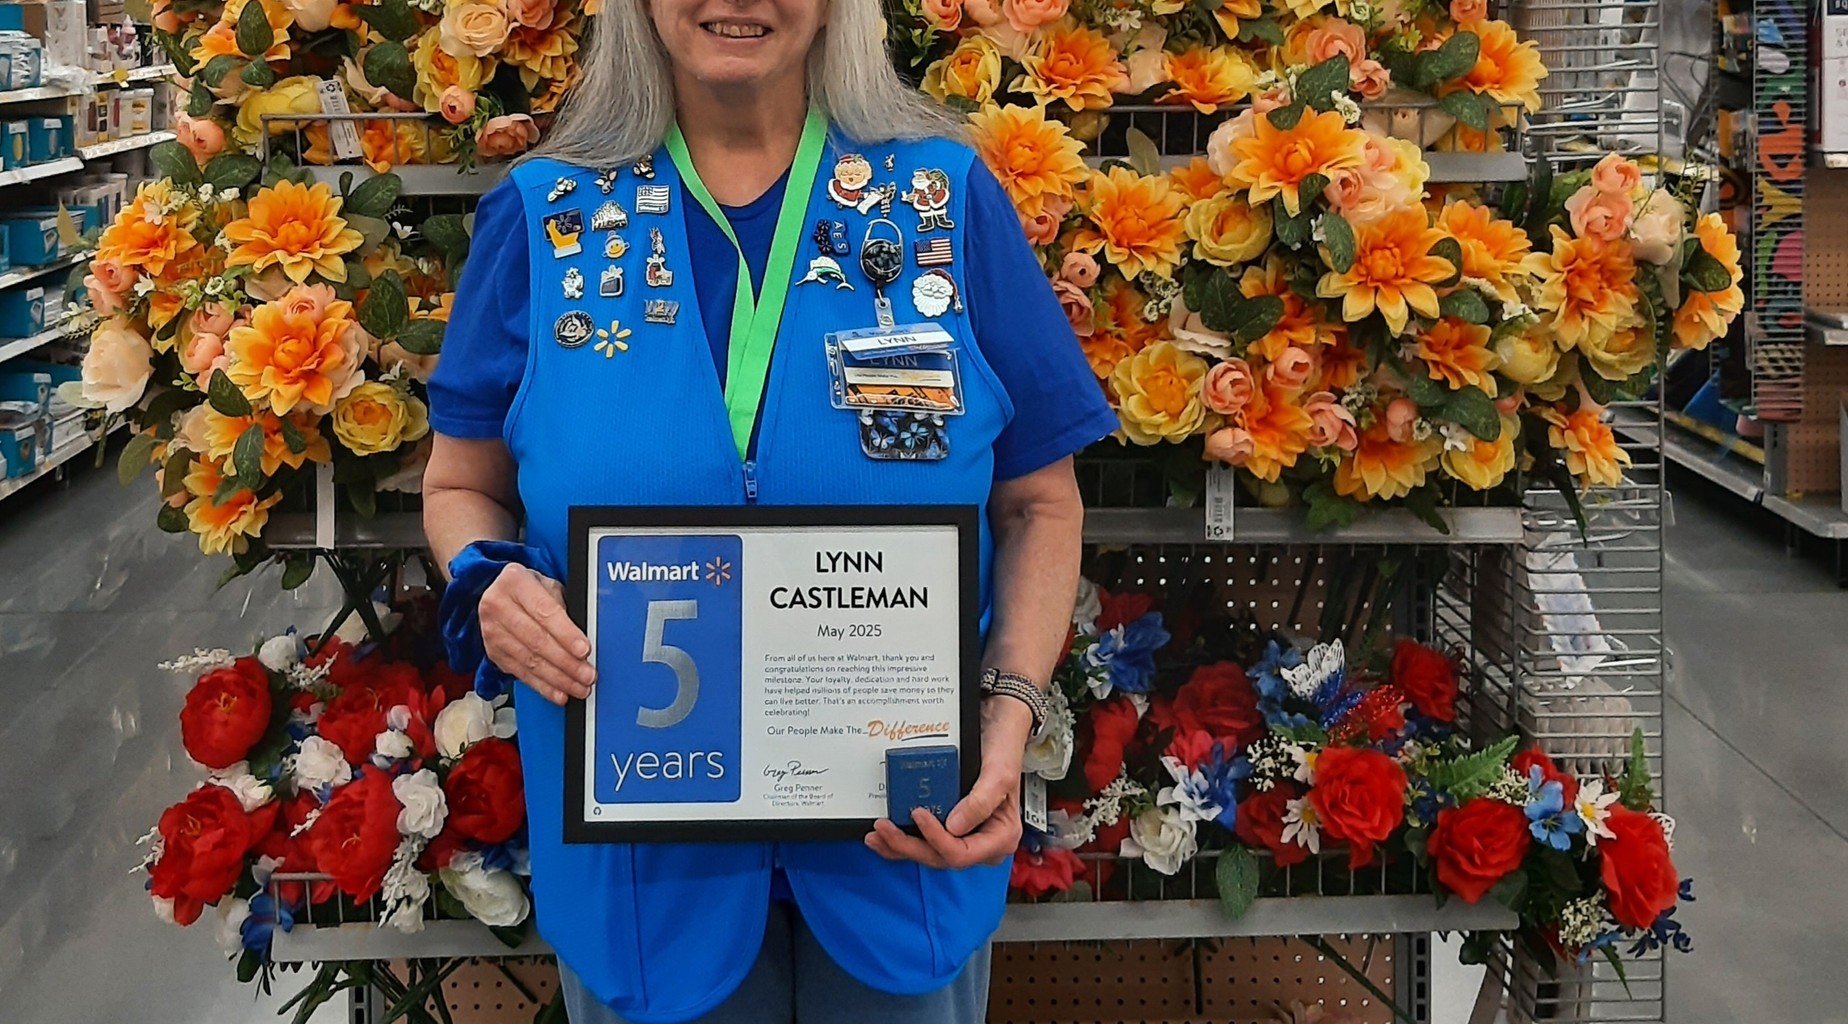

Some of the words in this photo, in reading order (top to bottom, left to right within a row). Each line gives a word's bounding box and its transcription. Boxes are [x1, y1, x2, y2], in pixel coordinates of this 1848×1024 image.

[878, 336, 916, 345] LYNN
[606, 560, 699, 581] Walmart
[816, 551, 883, 574] LYNN
[770, 586, 928, 610] CASTLEMAN
[817, 624, 844, 640] May
[849, 624, 882, 638] 2025
[636, 599, 700, 729] 5
[764, 654, 786, 662] From
[797, 654, 806, 662] of
[818, 654, 835, 662] here
[882, 654, 903, 662] thank
[905, 655, 920, 664] you
[764, 665, 824, 674] congratulations
[837, 665, 870, 674] reaching
[887, 665, 927, 674] impressive
[784, 687, 810, 696] helped
[852, 687, 879, 696] people
[899, 688, 925, 696] money
[937, 687, 955, 696] they
[858, 698, 920, 707] accomplishment
[767, 726, 785, 736] Our
[787, 726, 818, 738] People
[820, 726, 844, 735] Make
[868, 720, 950, 741] Difference
[610, 749, 725, 792] years
[774, 784, 793, 793] Greg
[919, 778, 931, 798] 5
